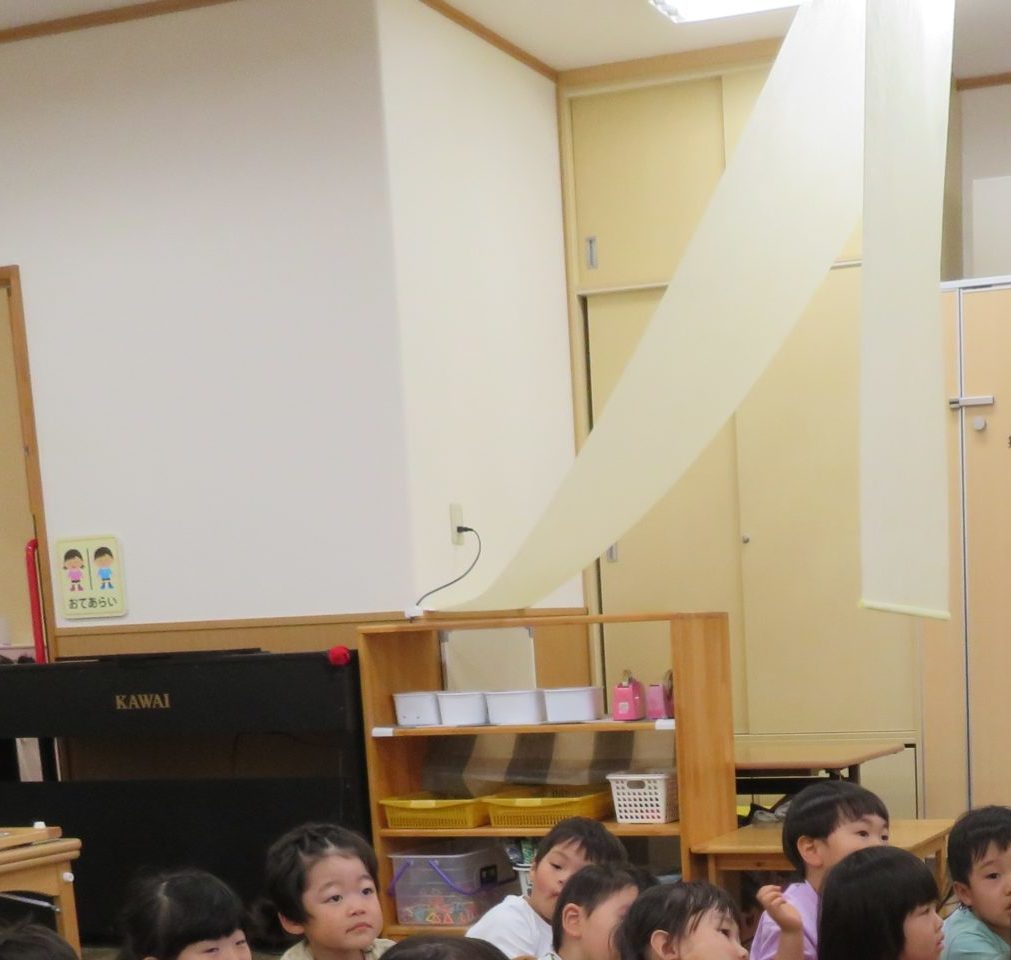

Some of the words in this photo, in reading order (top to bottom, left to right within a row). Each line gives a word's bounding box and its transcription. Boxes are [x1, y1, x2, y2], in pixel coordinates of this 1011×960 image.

[68, 596, 118, 610] おてあらい
[115, 693, 171, 710] KAWAI
